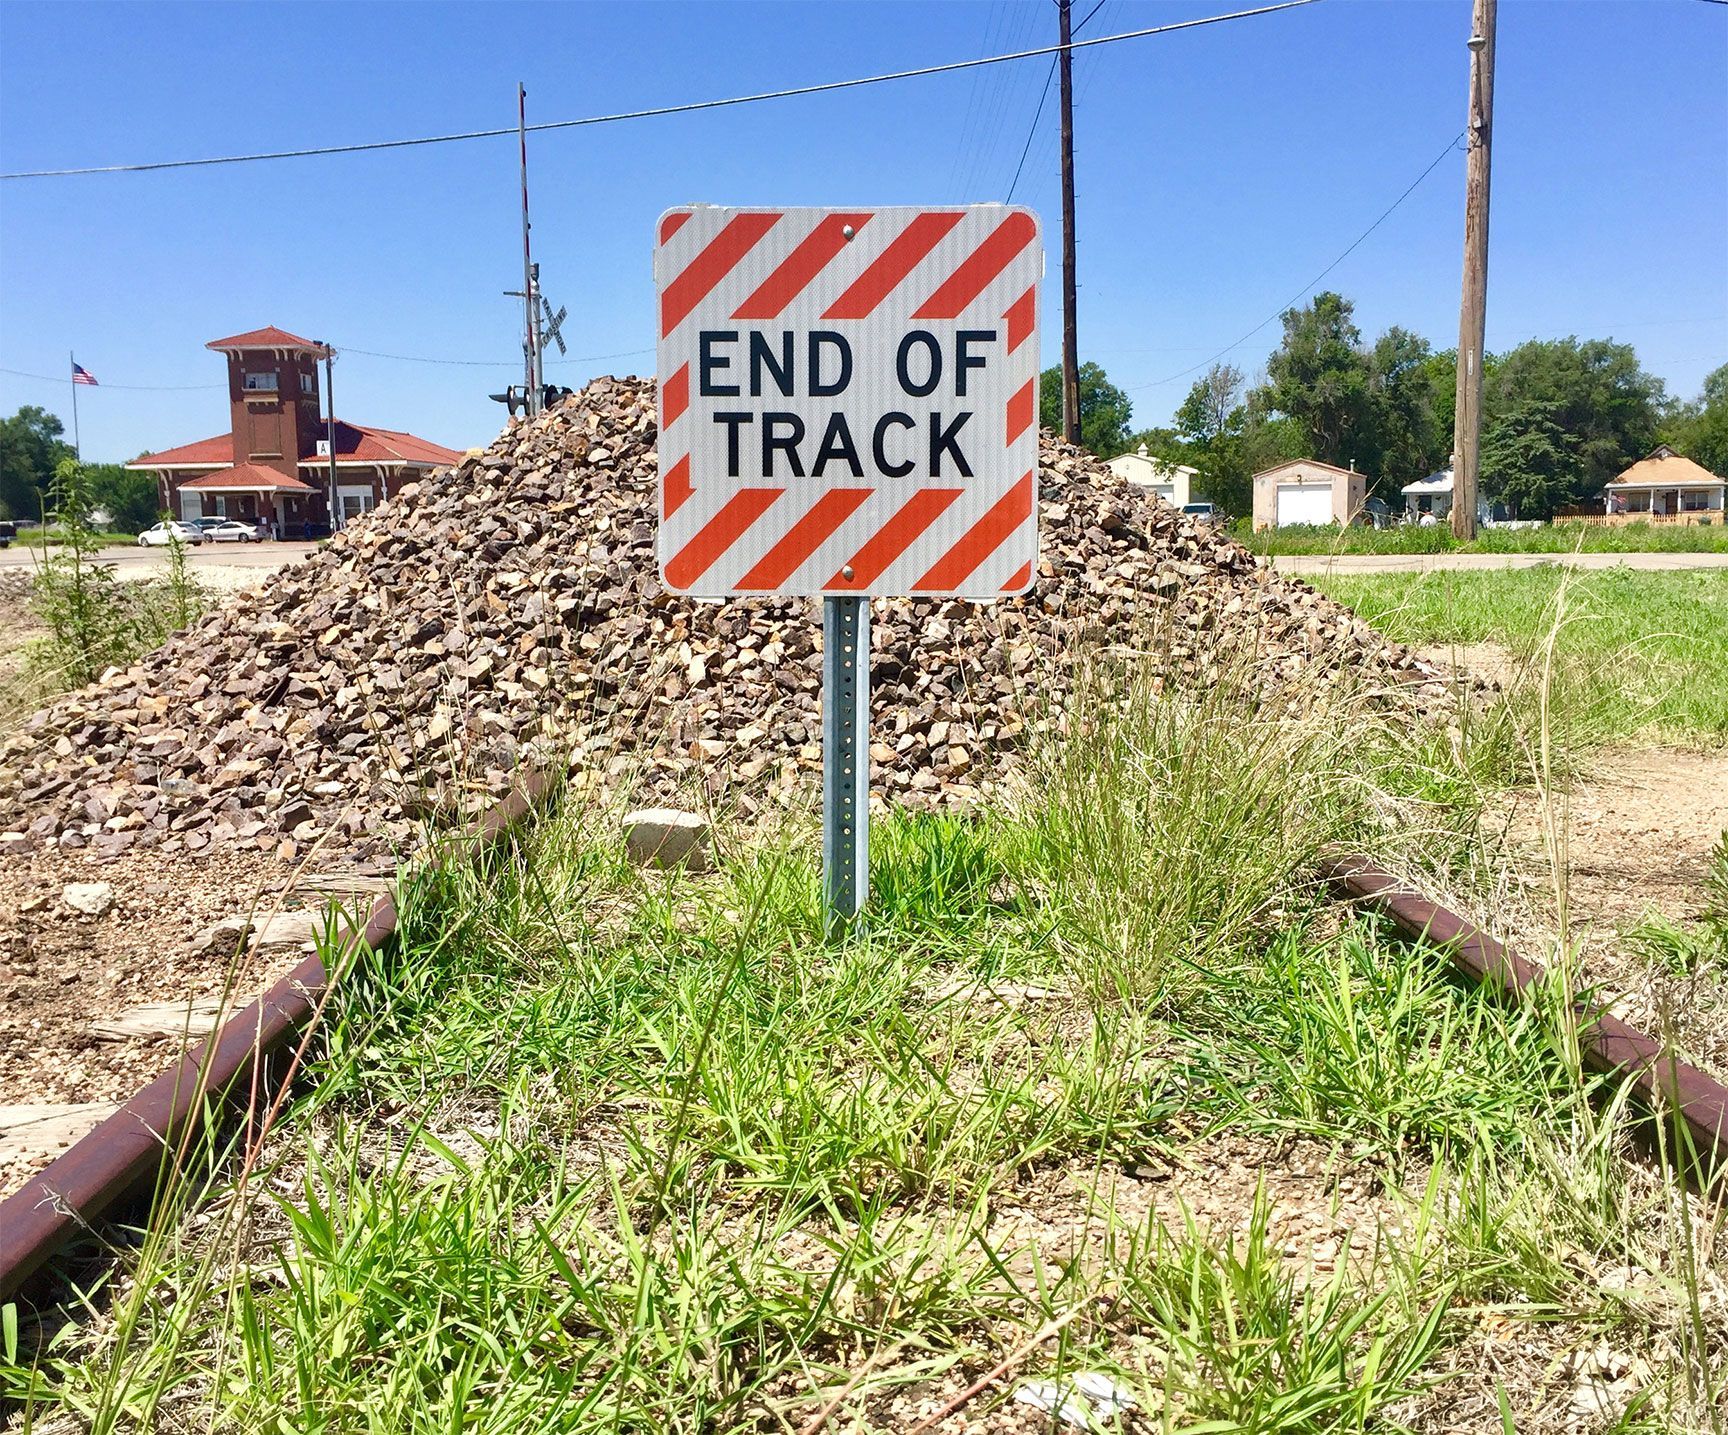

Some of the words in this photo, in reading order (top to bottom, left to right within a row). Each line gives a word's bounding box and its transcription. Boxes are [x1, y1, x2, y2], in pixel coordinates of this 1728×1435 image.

[700, 331, 853, 397] END
[897, 330, 997, 397] OF
[320, 443, 327, 454] A
[713, 412, 974, 478] TRACK
